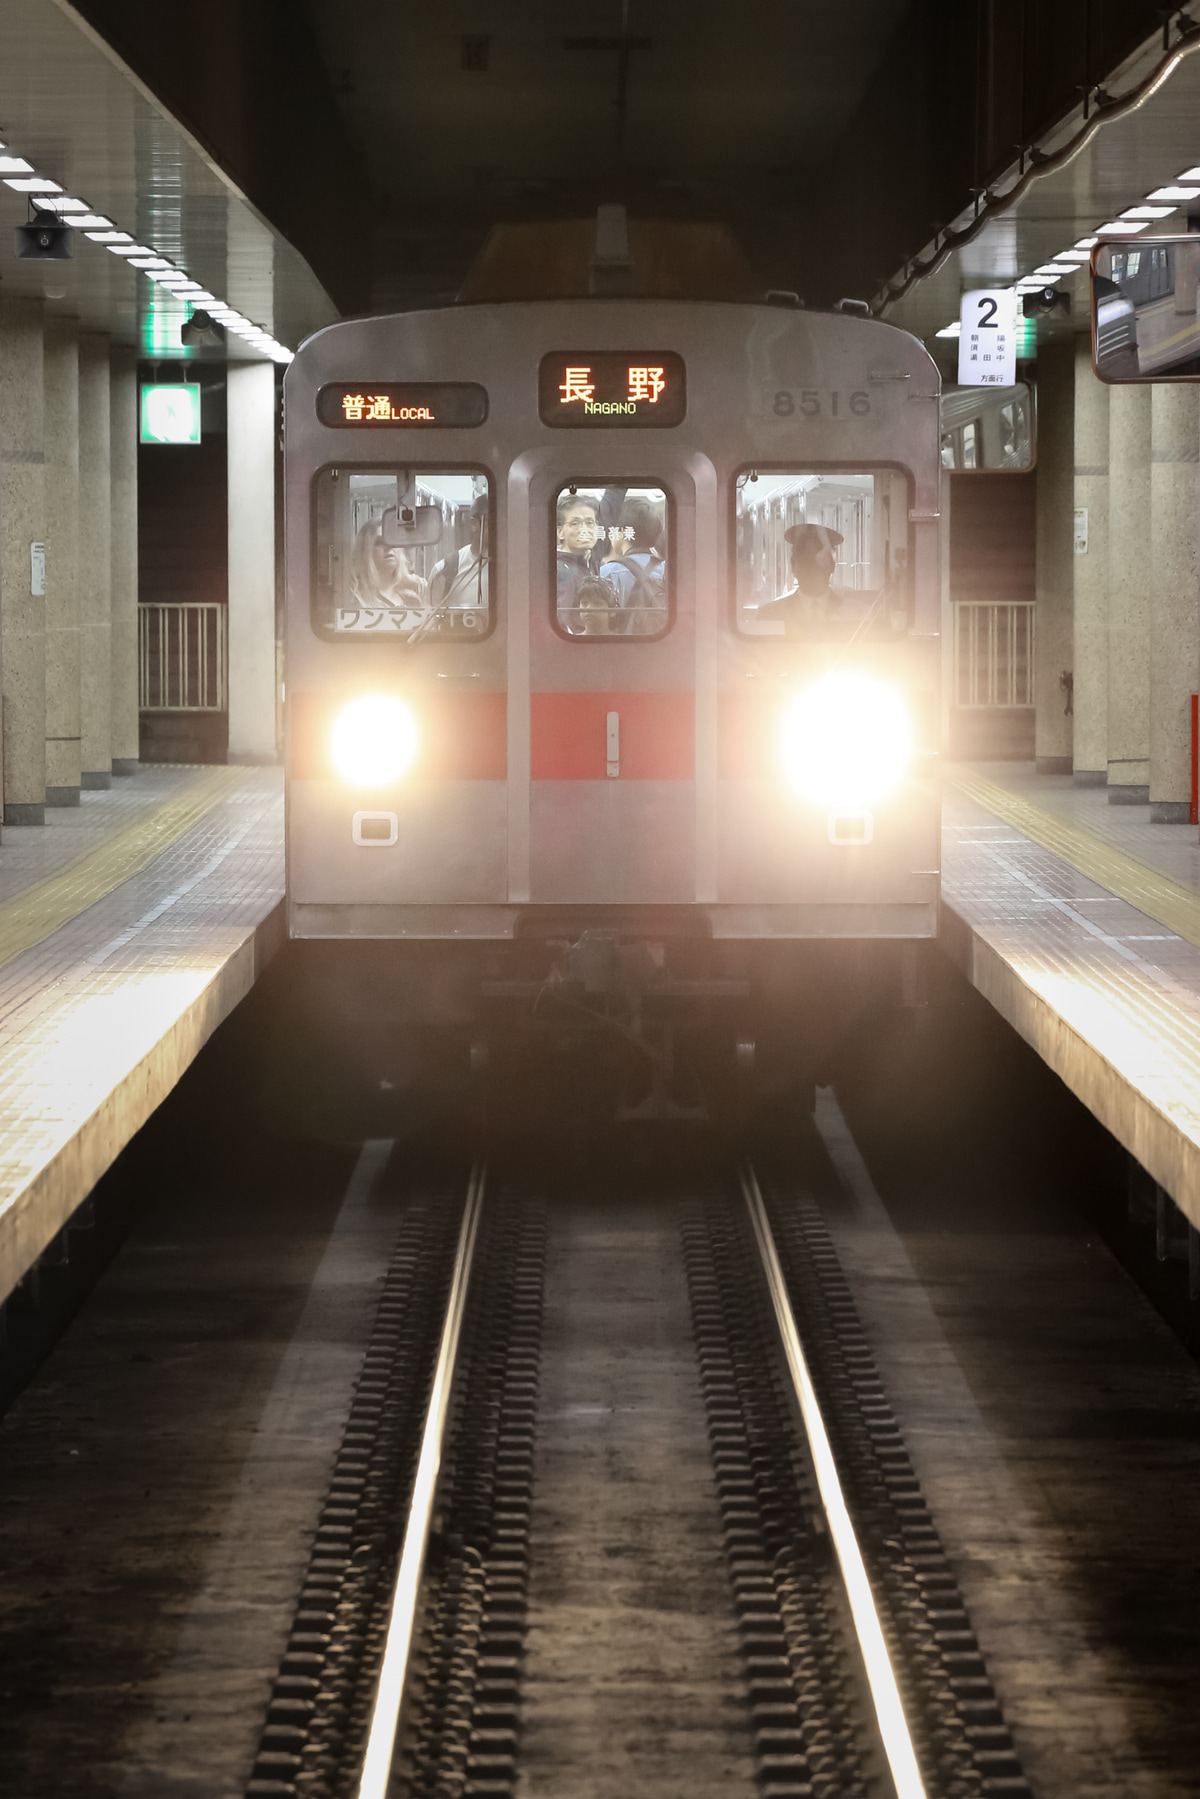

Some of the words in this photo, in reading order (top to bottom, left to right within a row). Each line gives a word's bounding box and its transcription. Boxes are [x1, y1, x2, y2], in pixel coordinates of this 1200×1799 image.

[977, 297, 998, 328] 2
[558, 367, 666, 403] 長野
[980, 374, 1004, 382] 方面行
[342, 394, 391, 420] 普通
[391, 408, 435, 420] LOCAL
[584, 402, 637, 414] NAGANO
[773, 391, 871, 417] 8516
